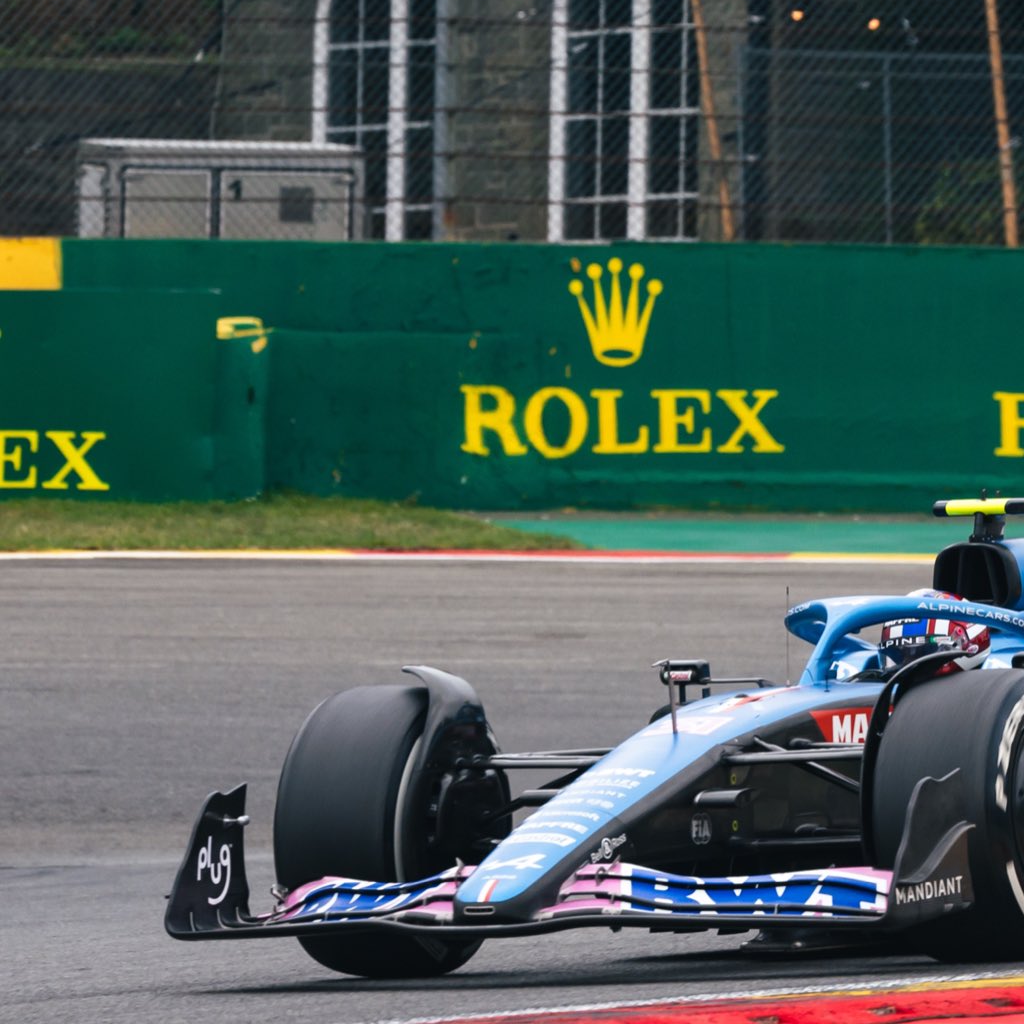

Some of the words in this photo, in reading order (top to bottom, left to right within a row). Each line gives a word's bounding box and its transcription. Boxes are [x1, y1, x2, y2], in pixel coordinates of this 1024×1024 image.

[461, 386, 784, 459] ROLEX
[197, 835, 232, 906] plug
[895, 875, 963, 905] MANDIANT
